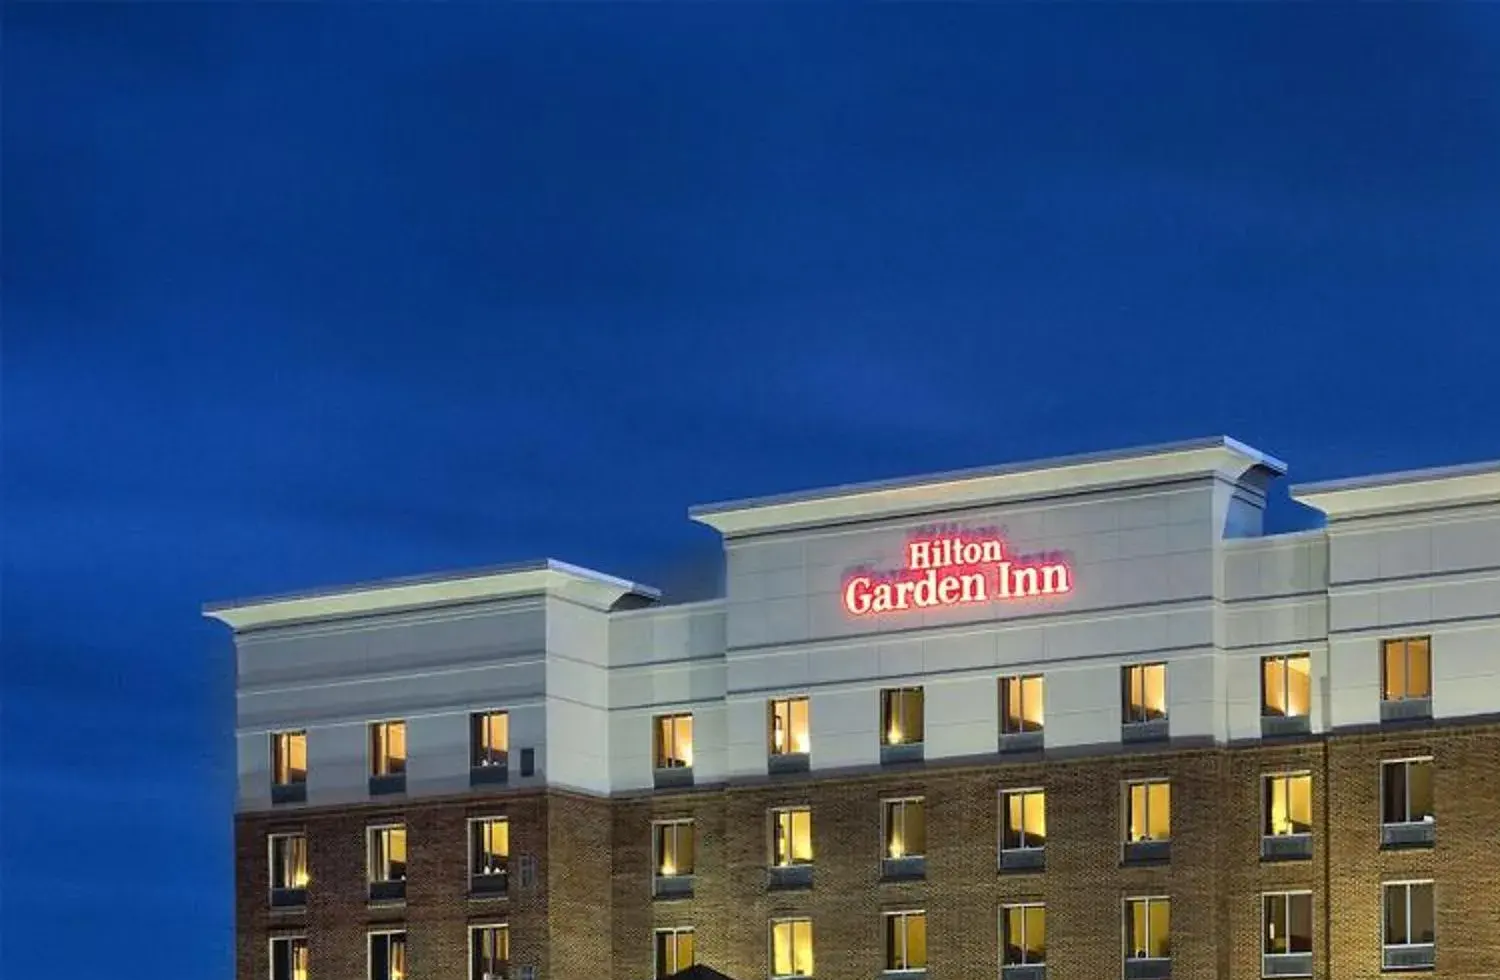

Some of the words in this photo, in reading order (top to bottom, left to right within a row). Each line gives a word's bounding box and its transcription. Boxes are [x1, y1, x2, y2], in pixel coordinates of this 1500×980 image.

[909, 538, 1002, 570] Hilton
[845, 570, 987, 614] Garden
[998, 562, 1070, 599] Inn
